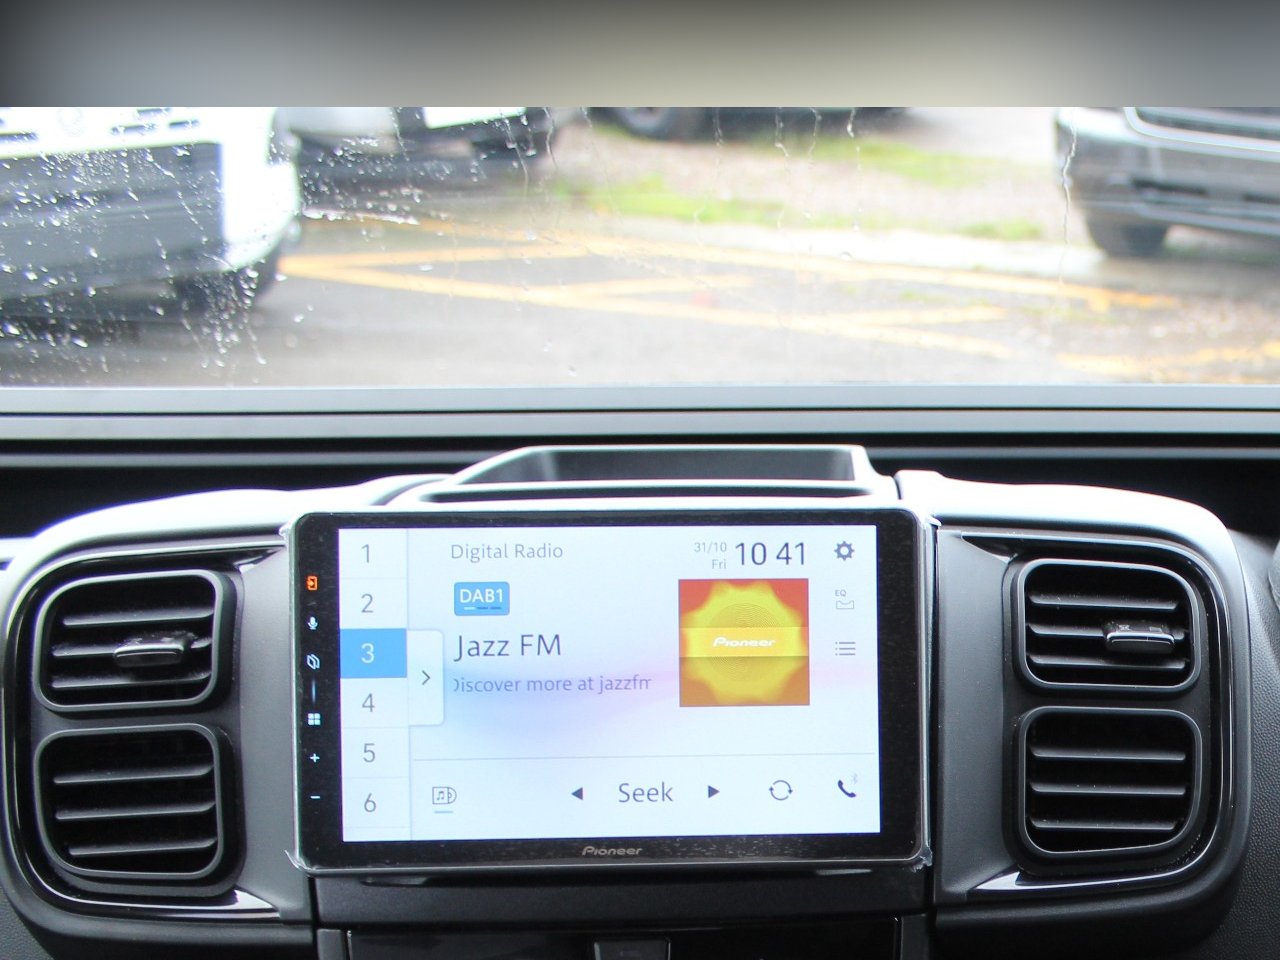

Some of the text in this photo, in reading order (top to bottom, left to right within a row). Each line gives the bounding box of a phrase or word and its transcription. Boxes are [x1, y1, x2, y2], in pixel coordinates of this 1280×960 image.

[361, 544, 371, 563] 1
[451, 543, 563, 563] Digital Radio
[694, 541, 727, 553] 31/10
[711, 559, 727, 569] Fri
[459, 588, 504, 603] DAB1
[835, 589, 847, 597] EQ
[361, 593, 374, 613] 2
[453, 634, 561, 662] Jazz FM
[712, 636, 776, 647] Pioneer
[361, 643, 374, 663] 3
[527, 678, 572, 691] more
[578, 677, 594, 691] at
[361, 692, 375, 713] 4
[363, 743, 376, 763] 5
[618, 781, 673, 803] Seek
[364, 793, 377, 813] 6
[582, 845, 643, 856] Pioneer
